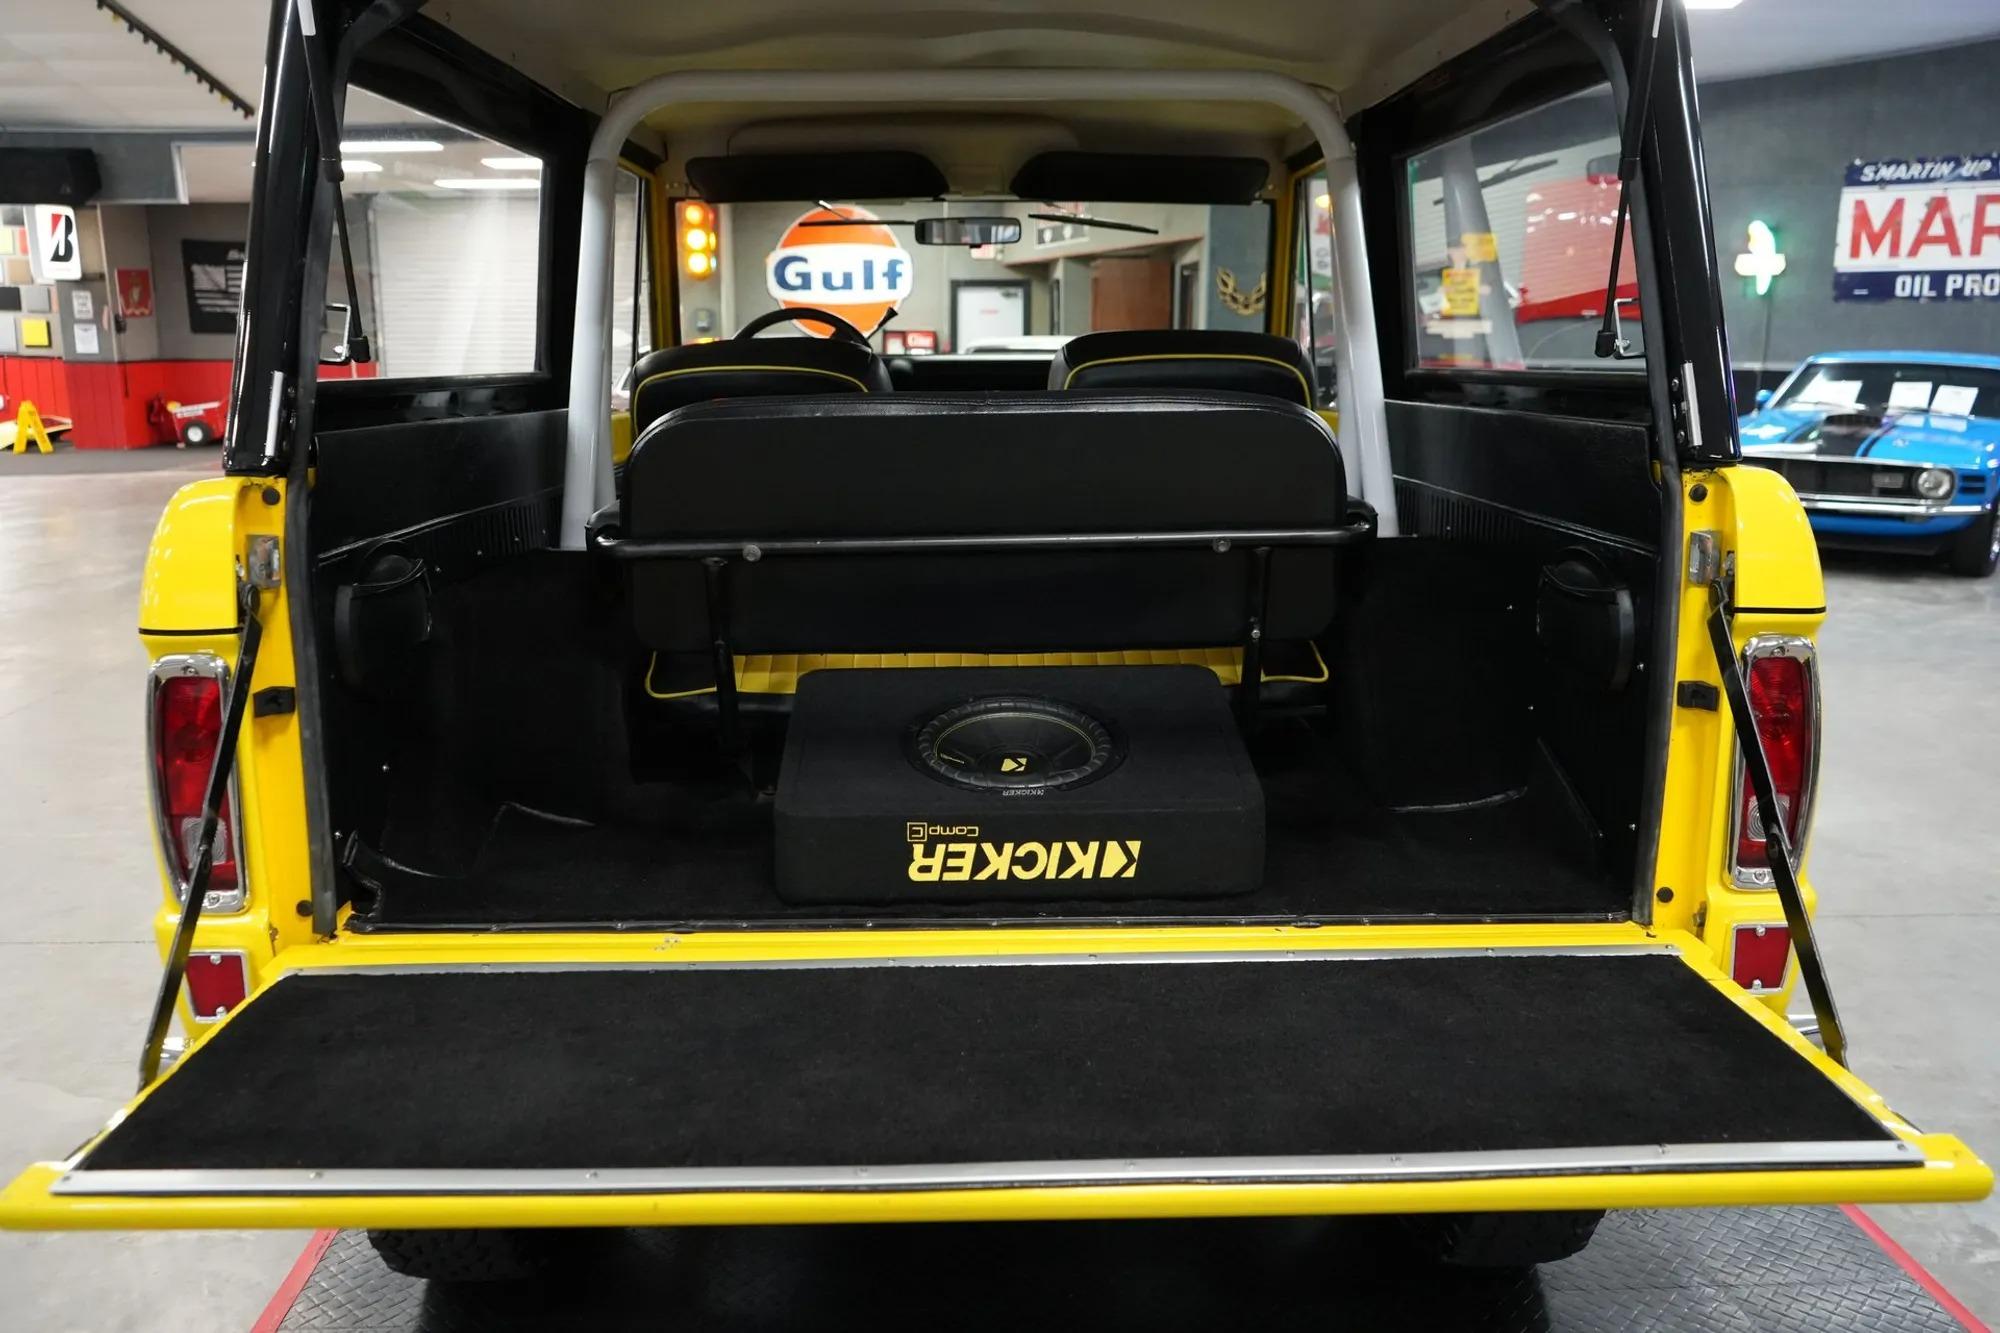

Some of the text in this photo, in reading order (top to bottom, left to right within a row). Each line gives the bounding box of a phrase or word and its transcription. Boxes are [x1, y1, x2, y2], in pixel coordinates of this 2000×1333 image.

[1961, 159, 1992, 176] UP
[774, 255, 904, 291] Gulf
[1895, 273, 2000, 297] OIL PRO
[908, 841, 1099, 882] KICKER
